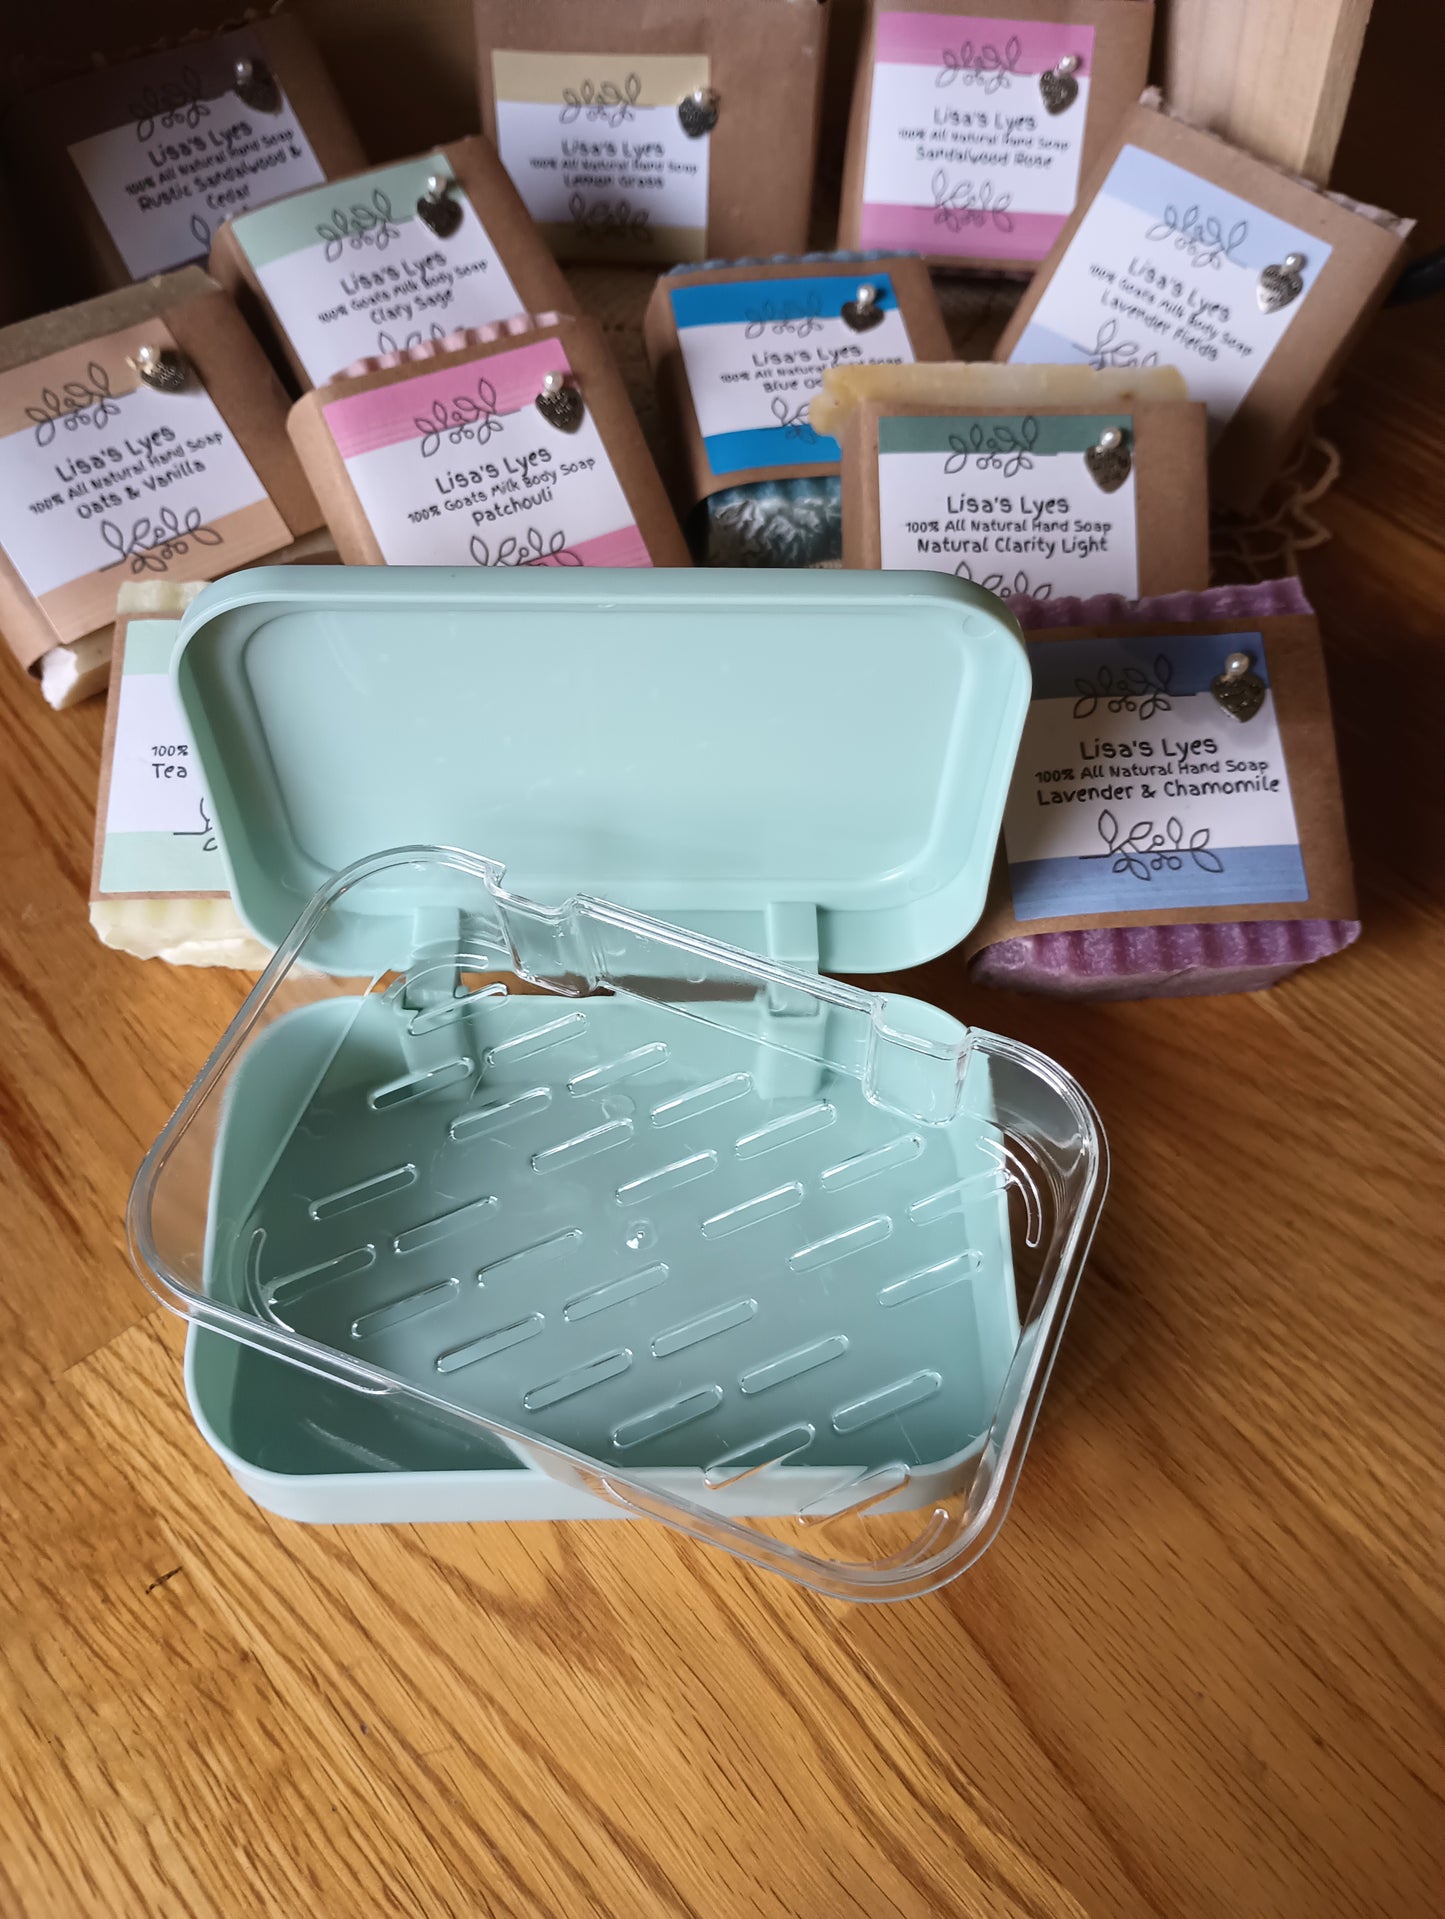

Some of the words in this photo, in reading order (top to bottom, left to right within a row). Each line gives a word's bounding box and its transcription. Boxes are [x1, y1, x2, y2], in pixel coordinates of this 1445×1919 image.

[934, 107, 988, 127] Lisa's
[994, 113, 1036, 135] Lyes
[148, 135, 207, 167] Lisa's
[207, 120, 252, 150] Lyes
[560, 138, 616, 157] Lisa's
[622, 140, 664, 160] Lyes
[917, 147, 1008, 166] Sandalwood
[137, 185, 192, 212] Rustic
[193, 153, 286, 192] Sandalwood
[340, 264, 400, 296] Lisa's
[401, 251, 447, 280] Lyes
[1128, 256, 1184, 297] Lisa's
[1187, 287, 1230, 323] Lyes
[370, 303, 413, 325] Clary
[752, 349, 812, 367] Lisa's
[817, 345, 862, 367] Lyes
[755, 368, 772, 379] All
[777, 363, 827, 377] Natural
[763, 380, 798, 393] Blue
[55, 445, 123, 482] Lisa's
[124, 425, 176, 456] Lyes
[28, 492, 65, 515] 100%
[67, 482, 88, 500] All
[90, 460, 147, 490] Natural
[149, 447, 185, 468] Hand
[186, 431, 223, 451] Soap
[435, 464, 499, 495] Lisa's
[503, 448, 552, 477] Lyes
[76, 492, 123, 519] Oats
[125, 485, 140, 500] &
[142, 458, 206, 491] Vanilla
[407, 505, 441, 523] 100%
[444, 491, 488, 511] Goats
[491, 481, 520, 497] Milk
[522, 470, 557, 487] Body
[560, 458, 596, 477] Soap
[946, 493, 1012, 514] Lisa's
[1020, 496, 1070, 520] Lyes
[906, 521, 939, 533] 100%
[944, 519, 965, 532] All
[970, 520, 1026, 532] Natural
[1032, 519, 1068, 532] Hand
[1074, 520, 1112, 535] Soap
[917, 537, 988, 553] Natural
[994, 537, 1056, 559] Clarity
[1061, 535, 1108, 558] Light
[151, 745, 189, 757] 100%
[1079, 738, 1153, 760] Lisa's
[1161, 738, 1218, 763] Lyes
[152, 763, 188, 779] Tea
[1034, 768, 1075, 783] 100%
[1080, 766, 1103, 780] All
[1109, 762, 1173, 778] Natural
[1178, 760, 1219, 775] Hand
[1226, 759, 1269, 774] Soap
[1037, 784, 1133, 806] Lavender
[1141, 785, 1155, 799] &
[1163, 775, 1280, 797] Chamomile
